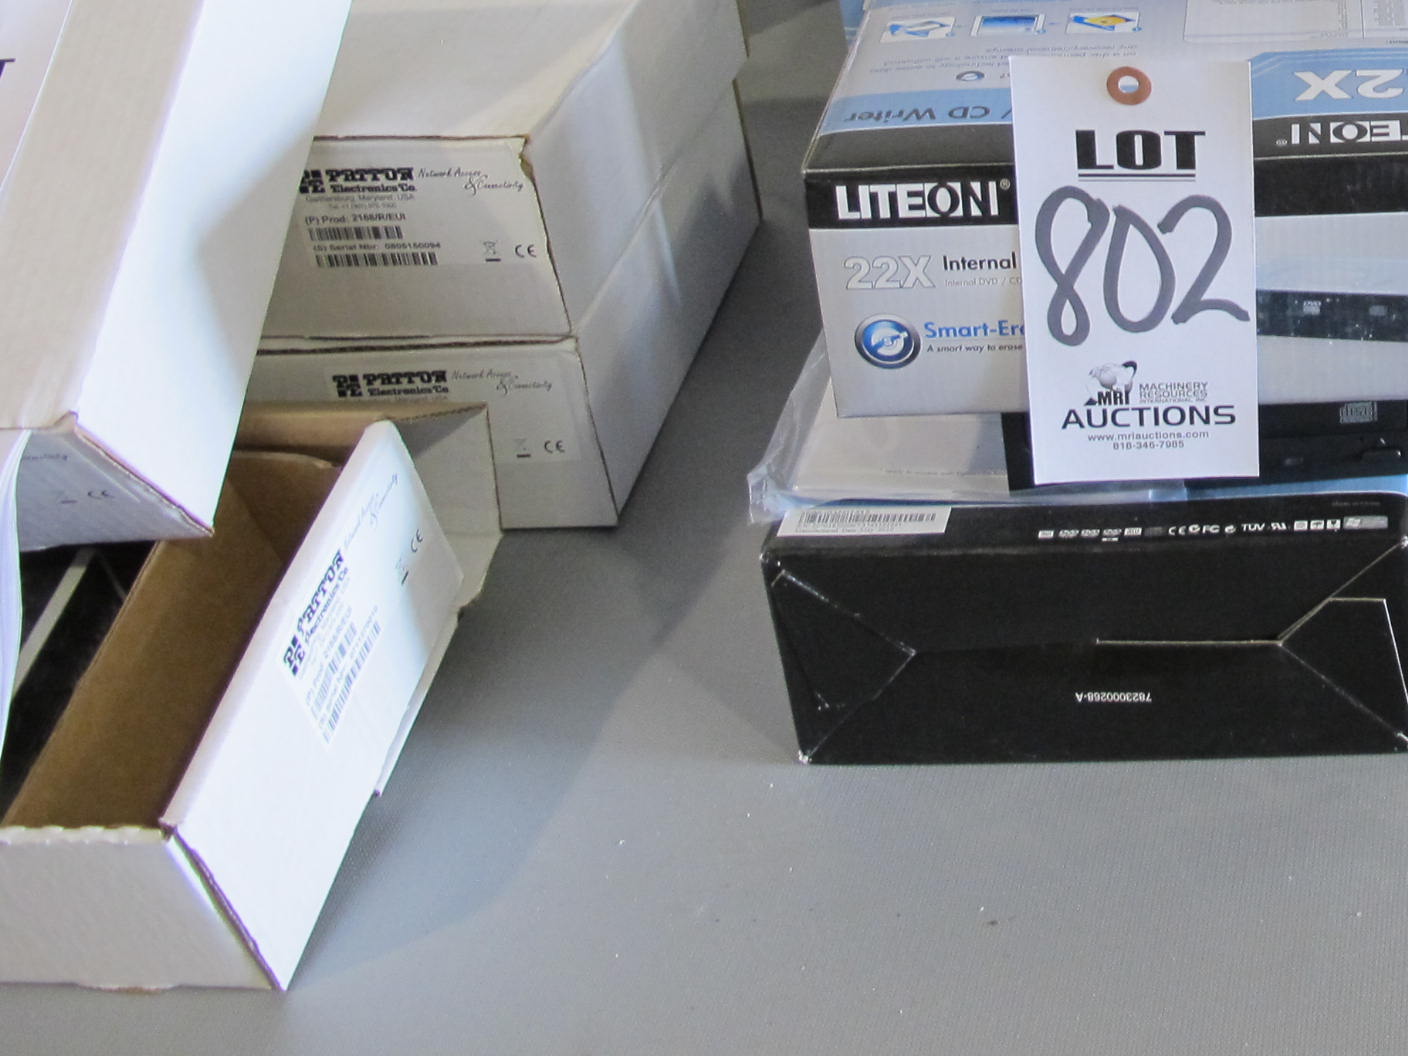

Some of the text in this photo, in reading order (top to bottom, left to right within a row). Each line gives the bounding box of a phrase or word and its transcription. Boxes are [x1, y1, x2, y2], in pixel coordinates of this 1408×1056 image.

[847, 106, 991, 122] CD Writer
[1075, 129, 1206, 171] LOT
[326, 167, 414, 181] PATTON
[330, 185, 395, 193] Electronics
[835, 181, 999, 219] LITEON
[305, 216, 319, 225] (P)
[515, 245, 536, 257] CE
[844, 252, 1016, 290] 22X Internal
[1035, 186, 1251, 346] 802
[945, 279, 976, 287] Internal
[965, 345, 984, 353] way
[363, 370, 447, 386] PATTON
[368, 387, 431, 396] Electronics
[1097, 382, 1208, 405] MRI MACHINERY
[1139, 390, 1208, 398] RESOURCES
[1061, 405, 1235, 429] AUCTIONS
[1088, 431, 1209, 441] www.mriauctions.com
[1075, 692, 1152, 702] 7823000268-A
